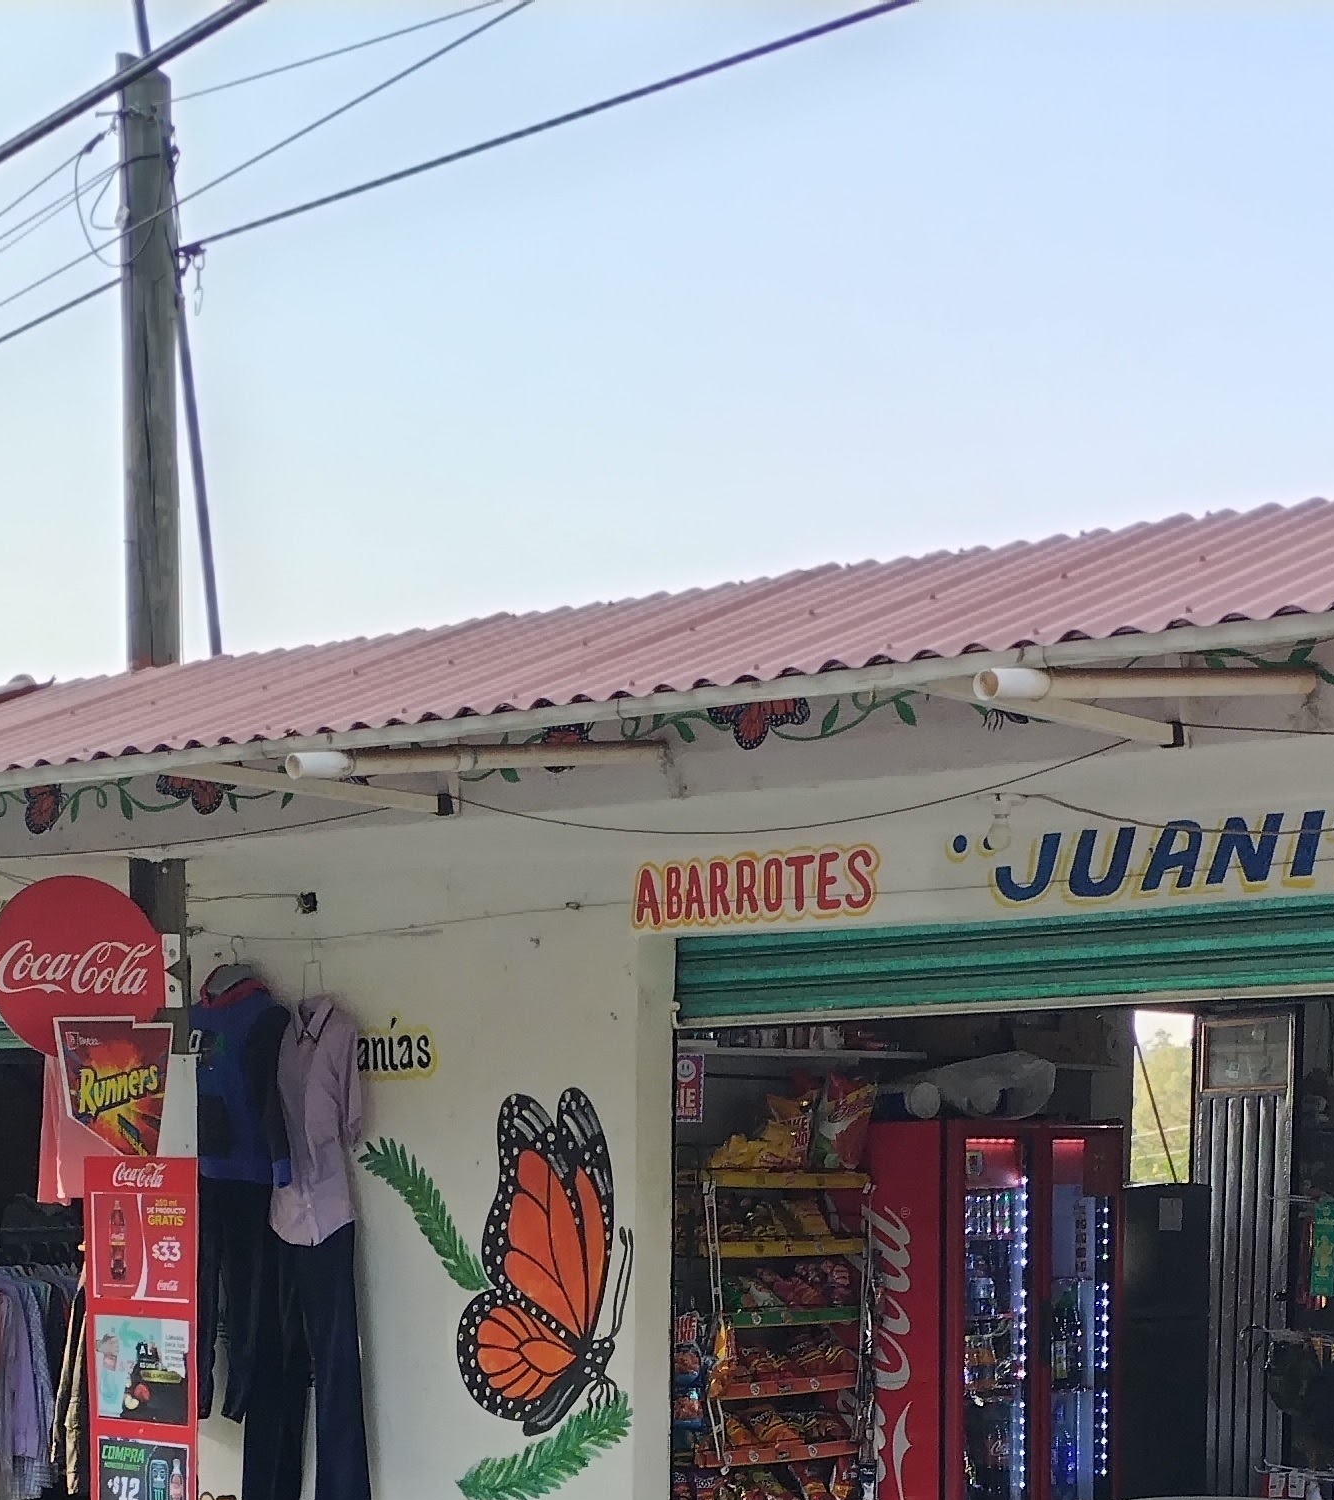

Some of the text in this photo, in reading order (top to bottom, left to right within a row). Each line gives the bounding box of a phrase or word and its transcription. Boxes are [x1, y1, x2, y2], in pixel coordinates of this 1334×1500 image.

[636, 849, 873, 926] ABARROTES
[356, 1016, 433, 1072] anías
[77, 1064, 159, 1117] Runners
[112, 1161, 167, 1188] Coca-Cola
[147, 1215, 185, 1227] GRATIS
[151, 1241, 181, 1262] $33
[101, 1444, 145, 1464] COMPRA
